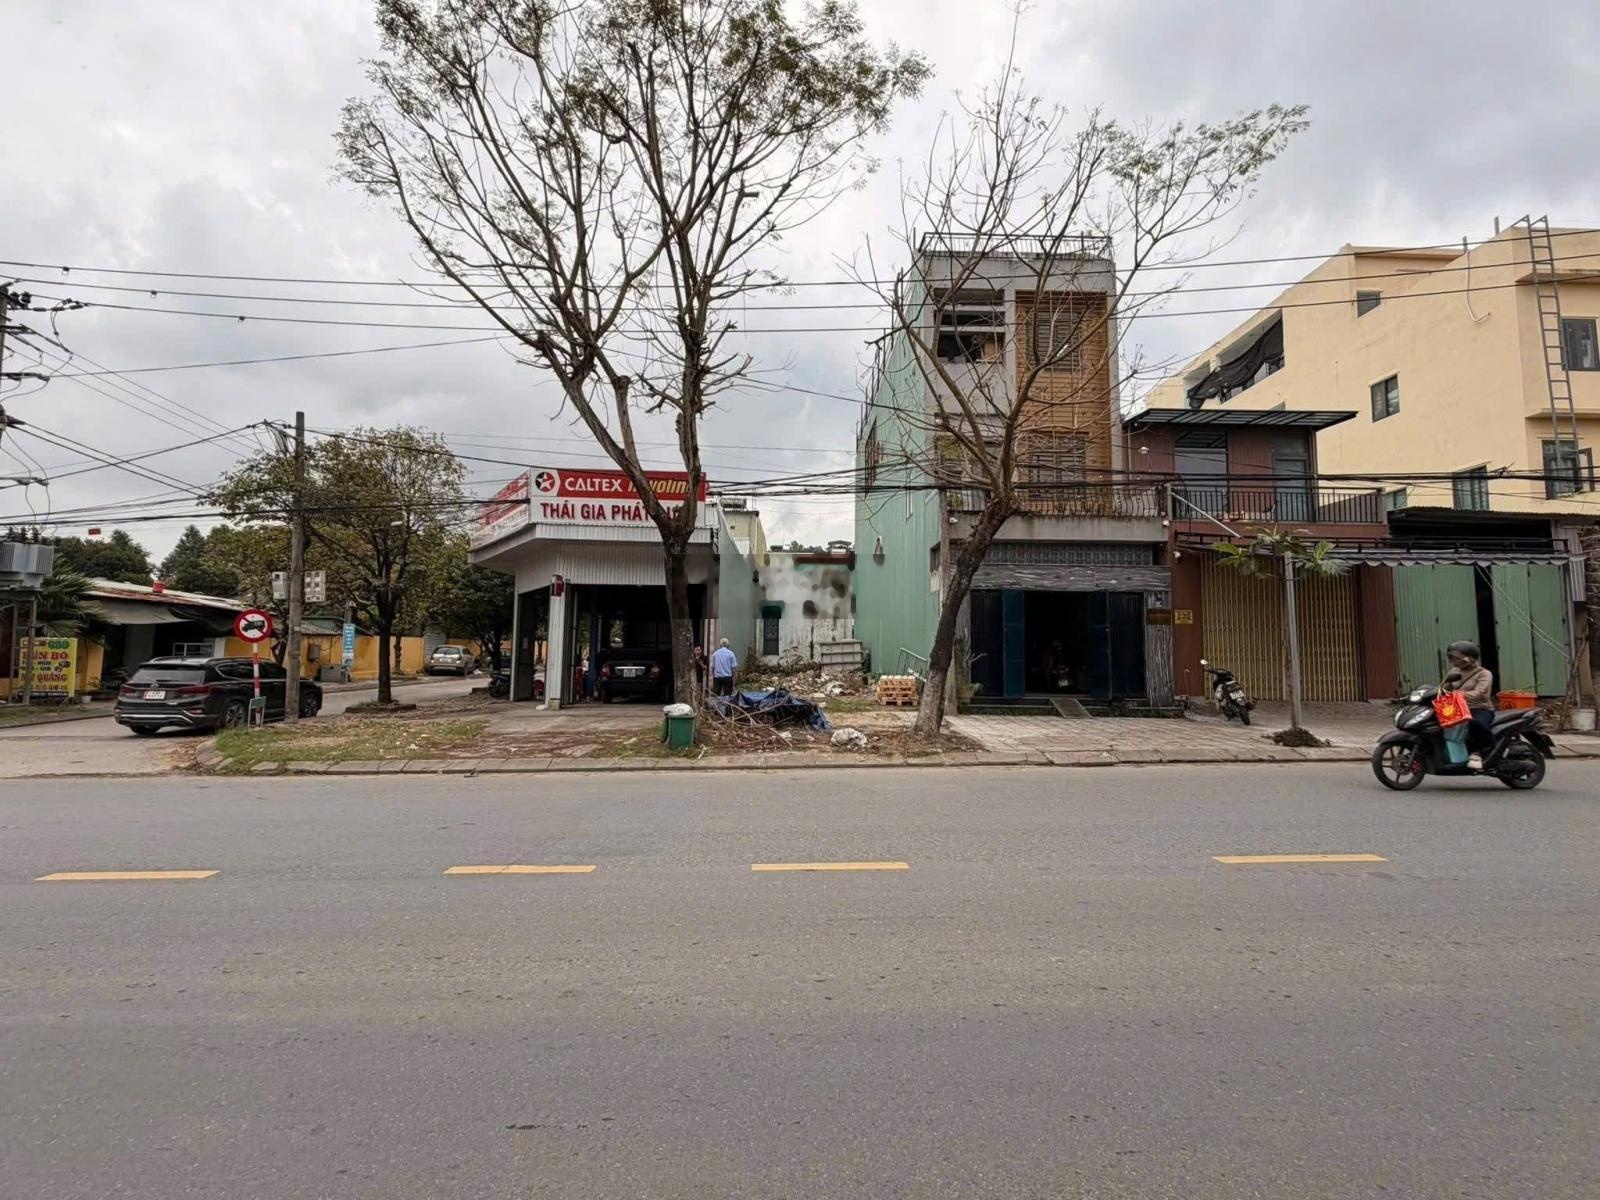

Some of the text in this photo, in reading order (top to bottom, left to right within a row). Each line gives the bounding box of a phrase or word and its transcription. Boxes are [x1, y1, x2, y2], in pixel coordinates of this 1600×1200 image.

[564, 477, 689, 494] CALTEX volin
[540, 499, 575, 520] THÁI
[580, 503, 607, 520] GIA
